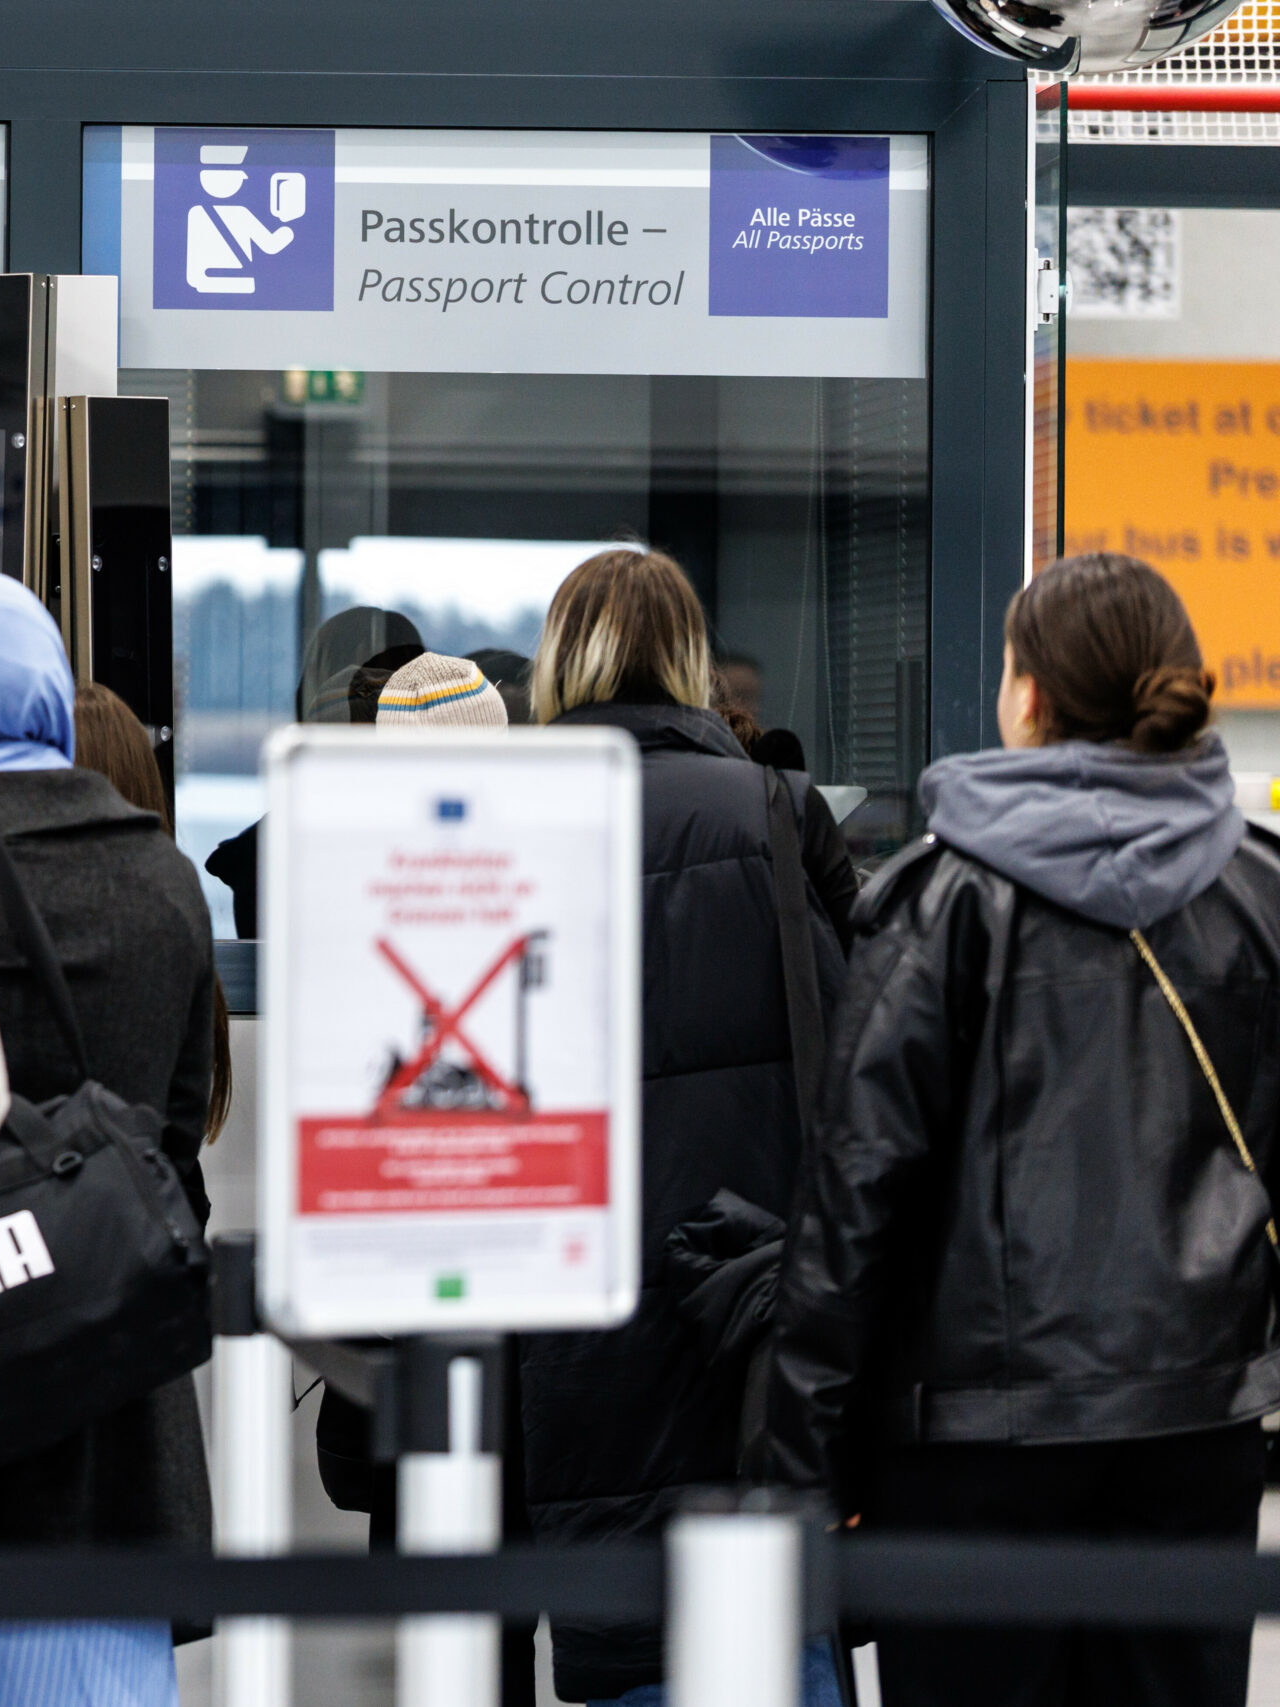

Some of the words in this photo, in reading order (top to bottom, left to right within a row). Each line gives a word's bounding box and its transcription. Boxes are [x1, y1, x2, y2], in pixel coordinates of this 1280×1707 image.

[361, 208, 629, 246] Passkontrolle
[749, 207, 791, 227] Alle
[798, 208, 856, 228] Pässe
[732, 229, 762, 249] All
[766, 230, 865, 255] Passports
[358, 268, 528, 313] Passport
[540, 270, 685, 306] Control
[1085, 399, 1200, 434] ticket
[1215, 402, 1252, 434] at
[1124, 526, 1201, 558] bus
[1217, 524, 1250, 558] is
